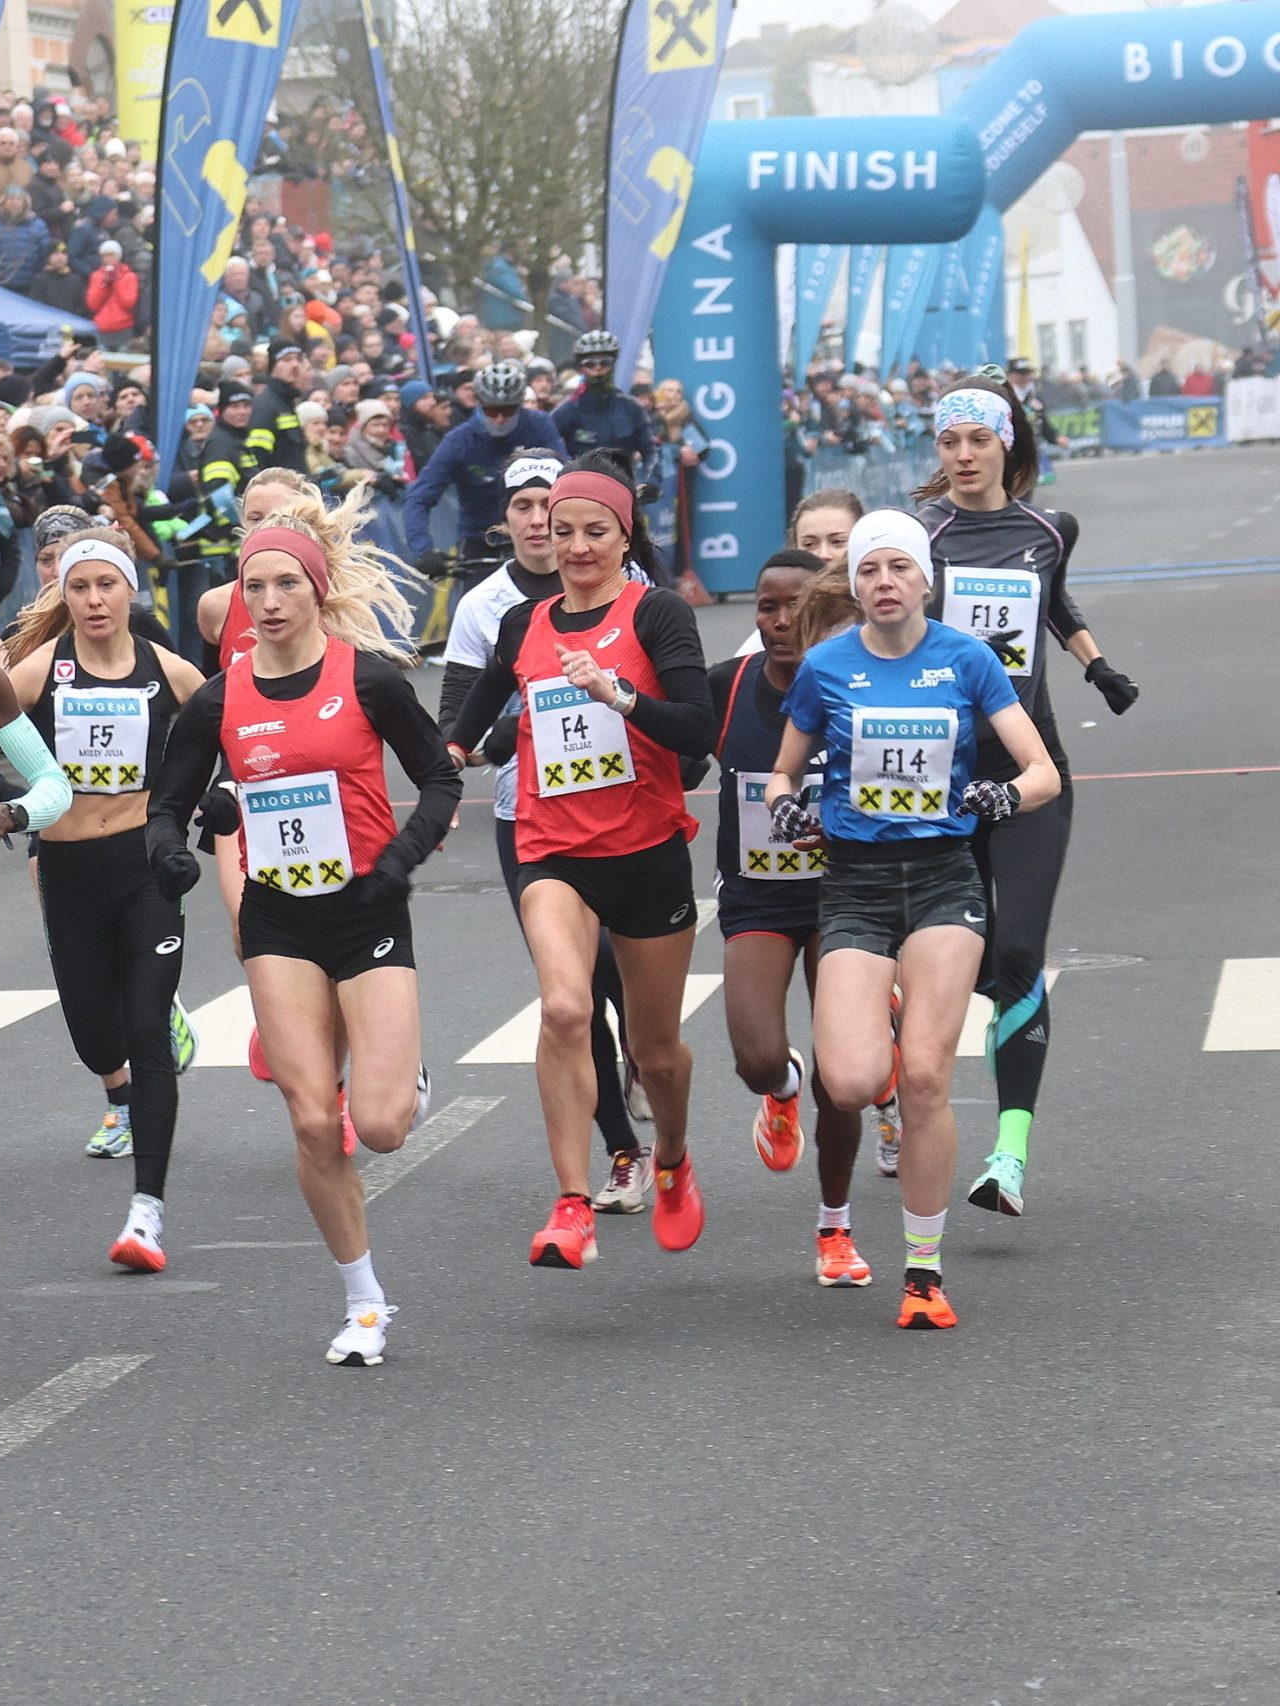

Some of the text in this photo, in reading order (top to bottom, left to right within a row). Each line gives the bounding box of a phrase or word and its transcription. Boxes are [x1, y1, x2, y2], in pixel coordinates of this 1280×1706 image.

[985, 102, 1048, 176] OURSELF
[749, 150, 938, 191] FINISH
[691, 223, 740, 560] BIOGENA
[957, 581, 1029, 594] BIOGENA
[970, 604, 1010, 628] F18
[66, 702, 137, 712] BIOGENA
[538, 689, 589, 707] BIOGE
[89, 724, 114, 748] F5
[561, 714, 590, 742] F4
[865, 722, 946, 735] BIOGENA
[882, 748, 928, 773] F14
[252, 790, 327, 808] BIOGENA
[278, 818, 305, 847] F8
